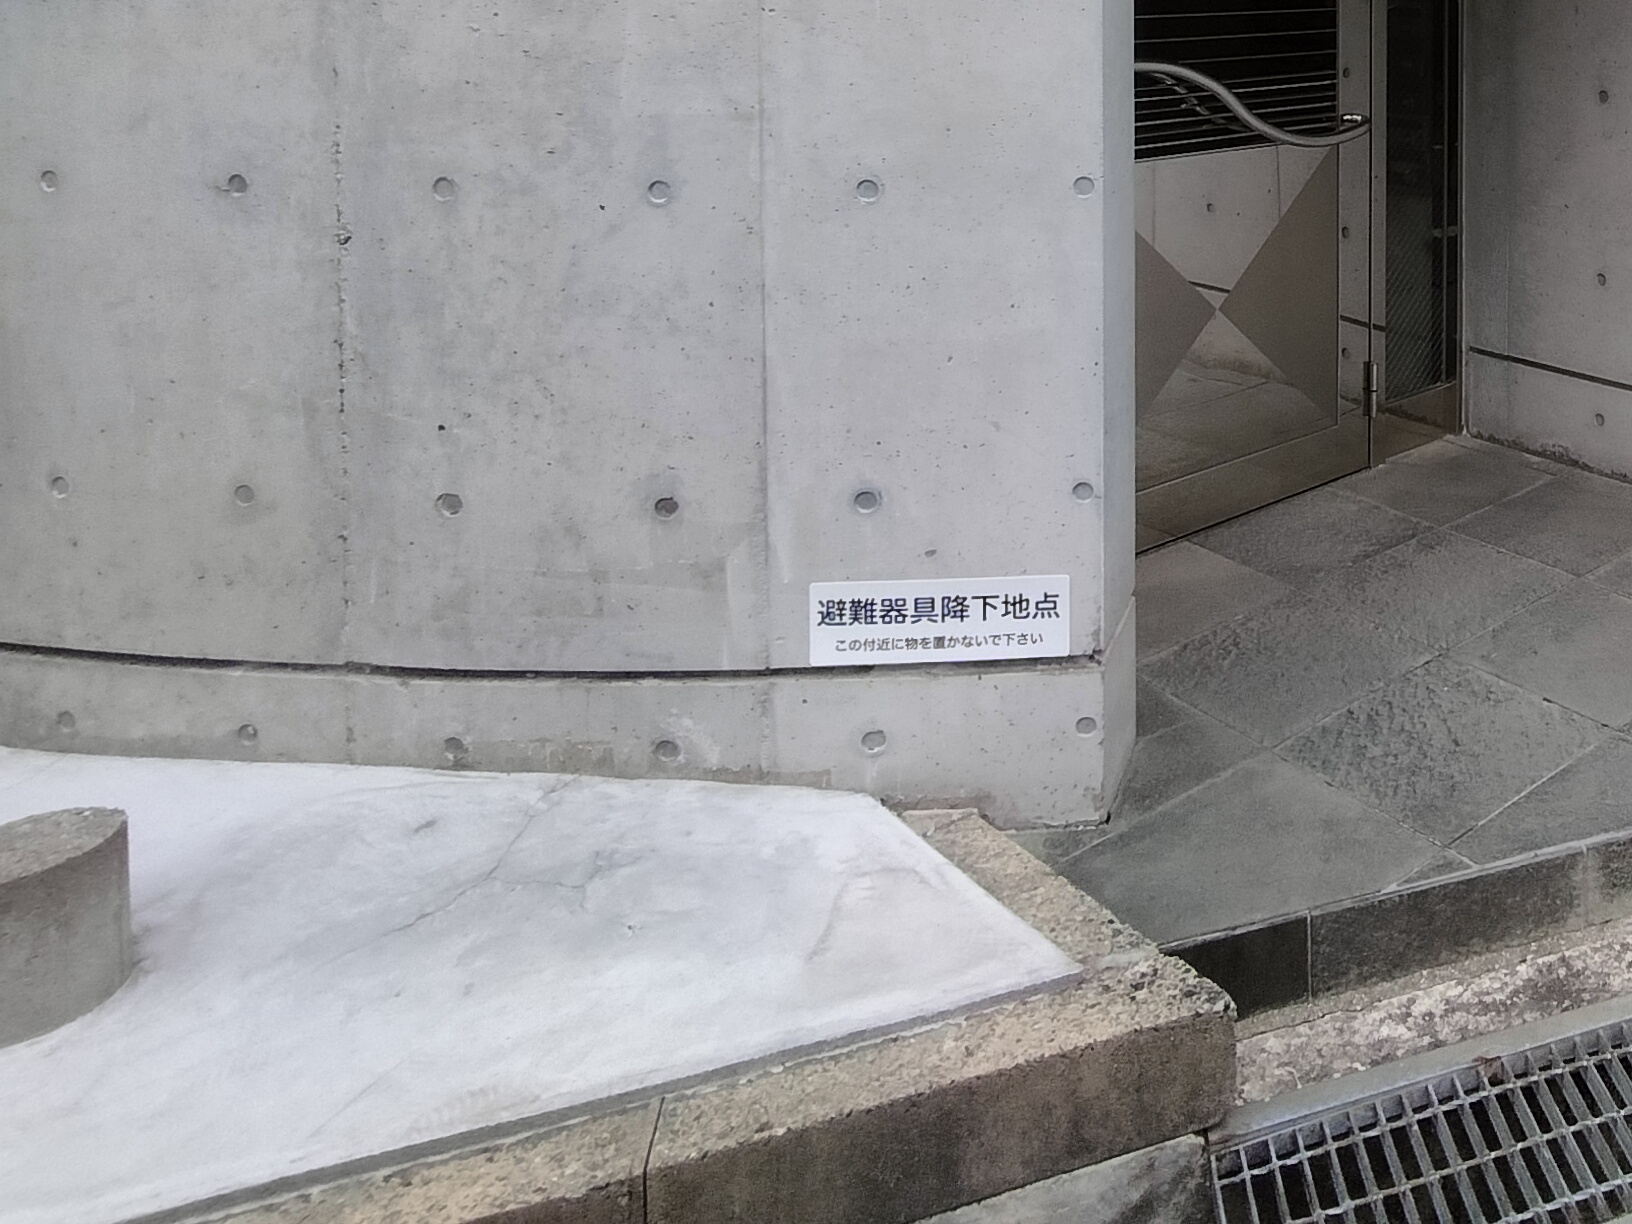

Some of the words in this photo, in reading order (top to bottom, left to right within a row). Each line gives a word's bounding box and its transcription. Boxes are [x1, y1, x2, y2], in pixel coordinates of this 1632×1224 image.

[817, 592, 1060, 627] 避難器具降下地点
[834, 633, 1044, 652] この付近に物を置かないで下さい
